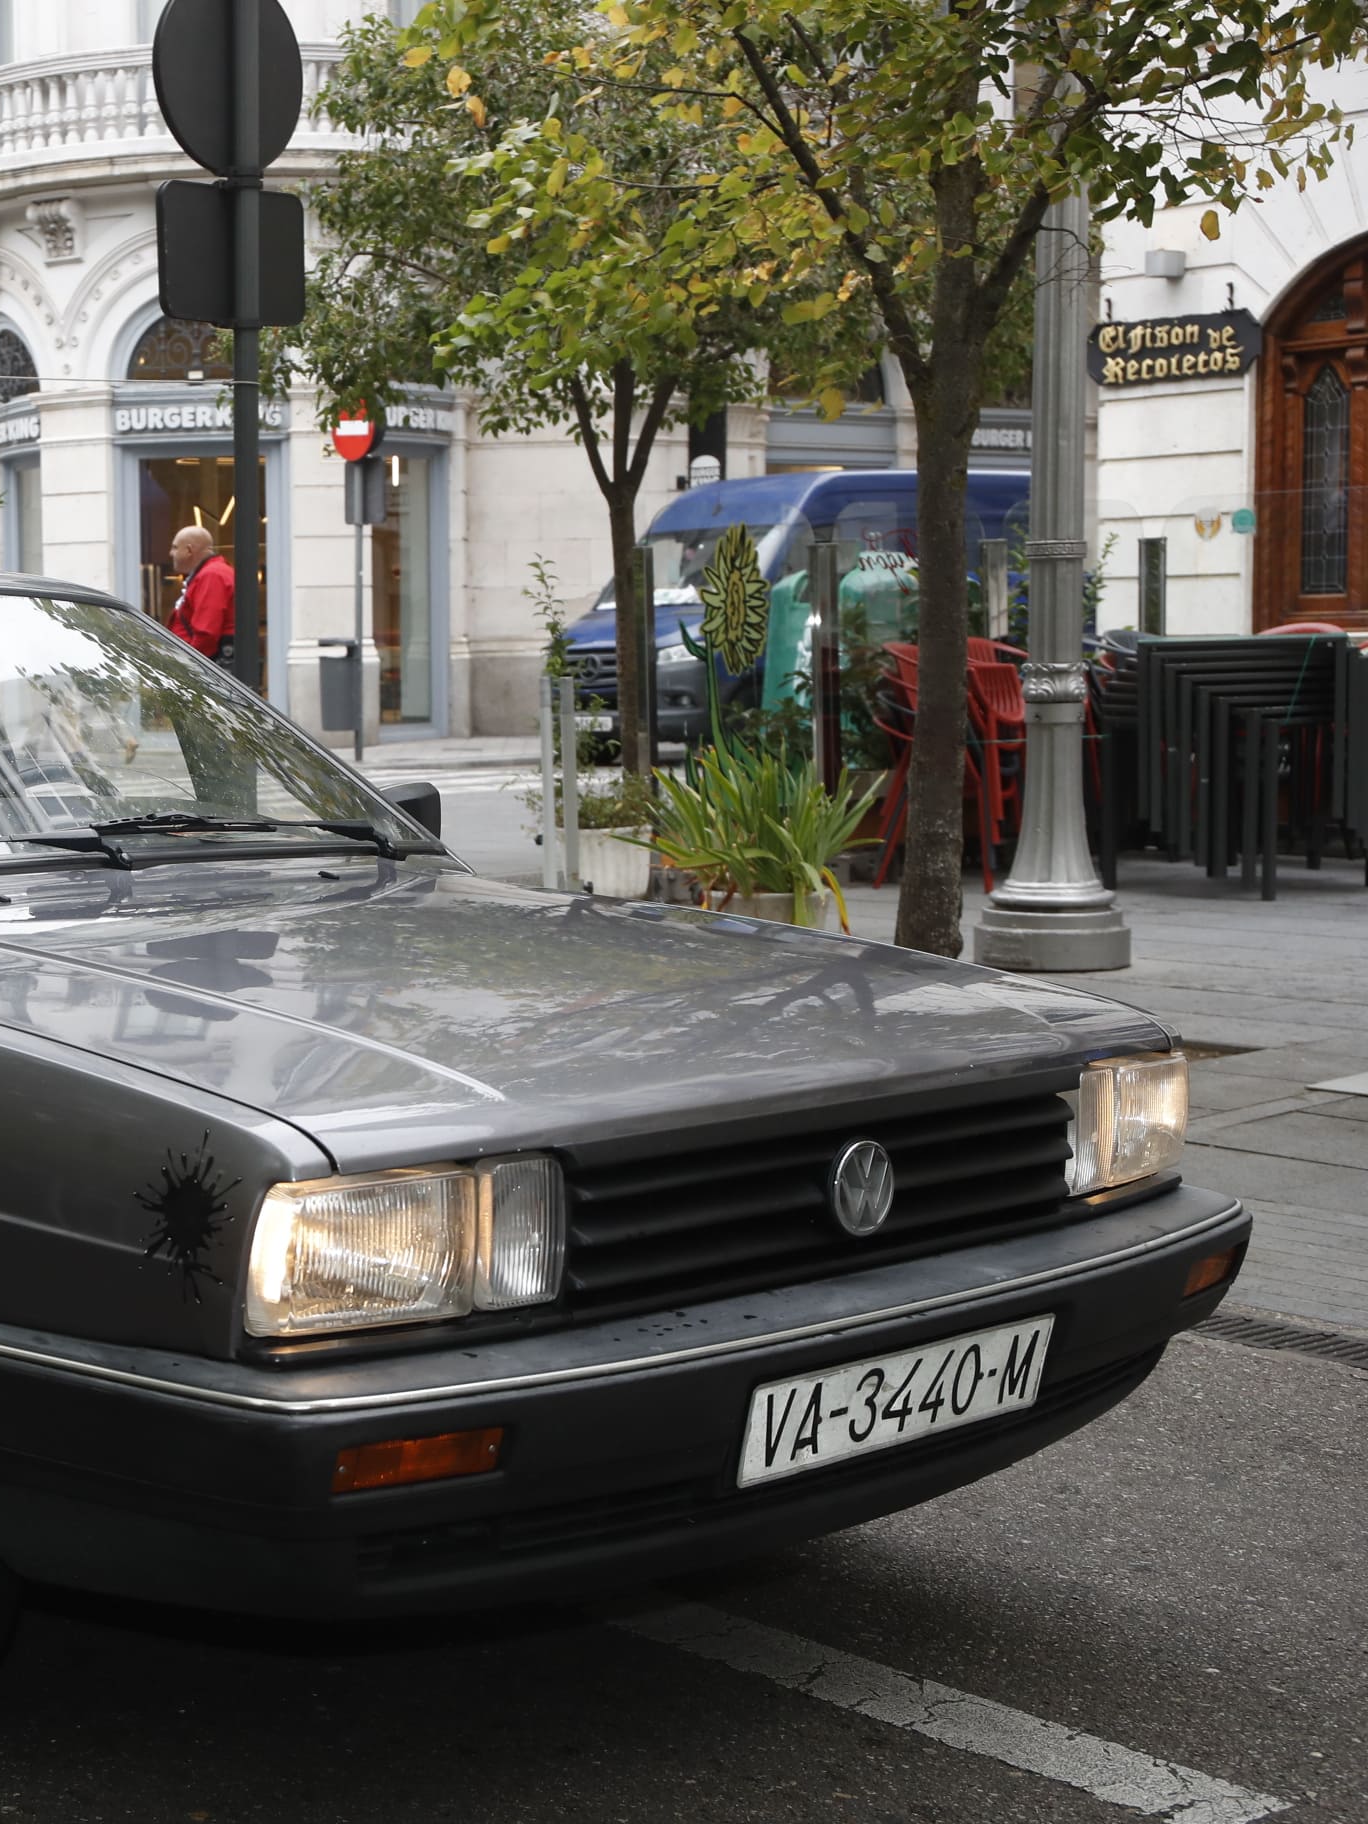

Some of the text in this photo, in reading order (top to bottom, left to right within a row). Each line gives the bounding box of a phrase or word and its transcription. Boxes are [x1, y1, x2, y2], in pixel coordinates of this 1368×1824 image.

[1099, 324, 1126, 352] El
[1207, 325, 1237, 349] de
[1102, 346, 1245, 385] Recoletos
[115, 404, 283, 431] BURGER KG
[765, 1329, 1041, 1468] VA-3440-M
